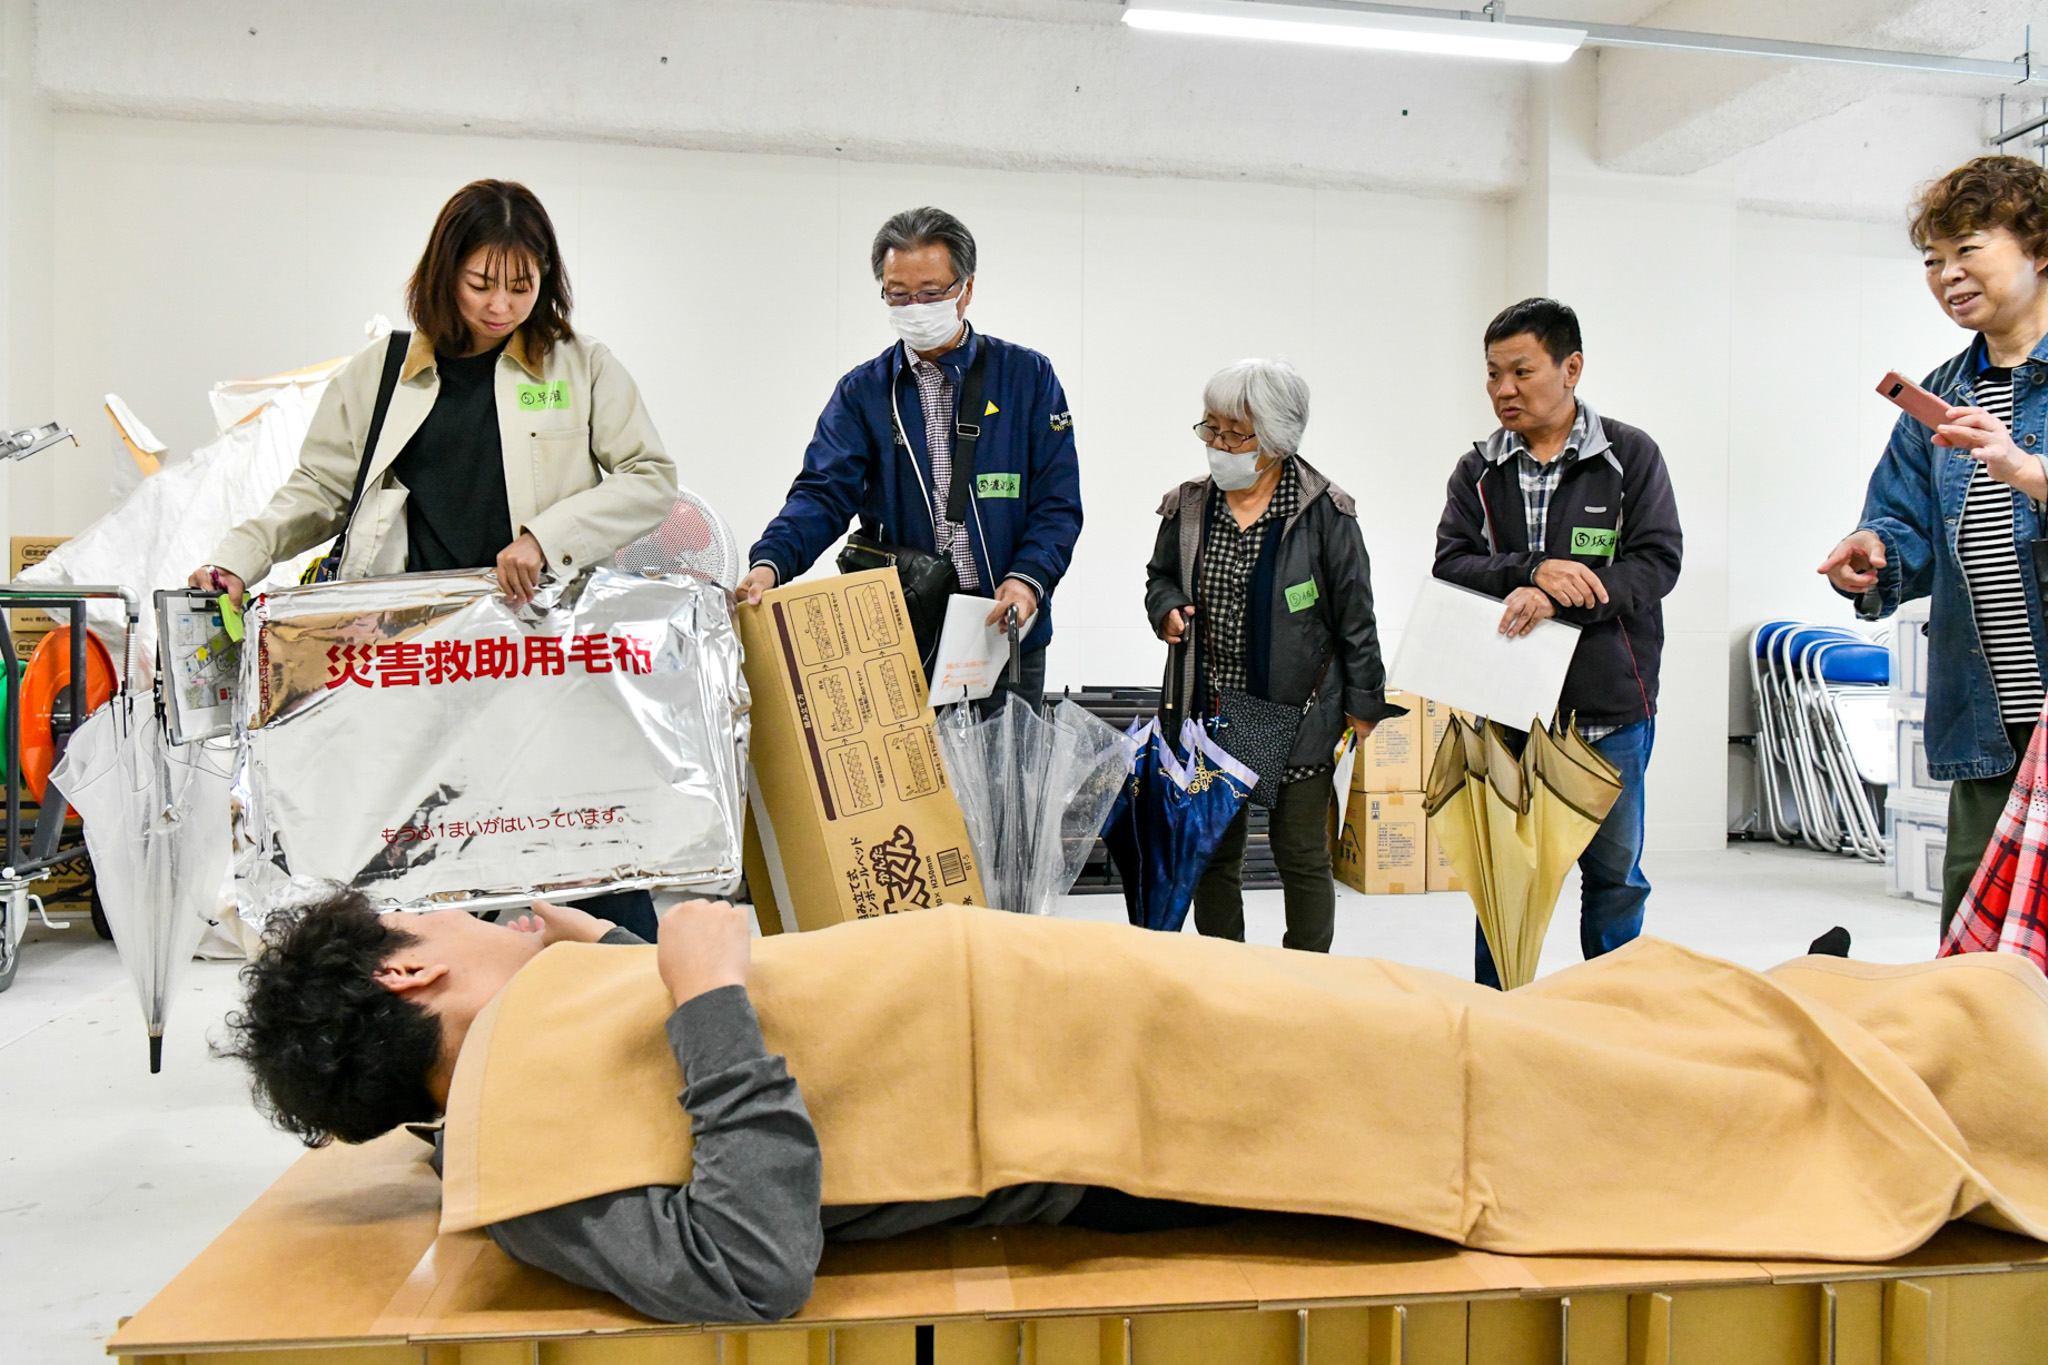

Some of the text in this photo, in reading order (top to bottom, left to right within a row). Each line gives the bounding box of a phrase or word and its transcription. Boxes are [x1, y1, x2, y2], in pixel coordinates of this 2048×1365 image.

[324, 632, 653, 690] 災害救助用毛布
[796, 693, 812, 729] 組み立て方
[381, 808, 624, 844] もうふ1まいがはいっています。
[870, 844, 890, 887] かんた
[925, 855, 938, 889] H250mm
